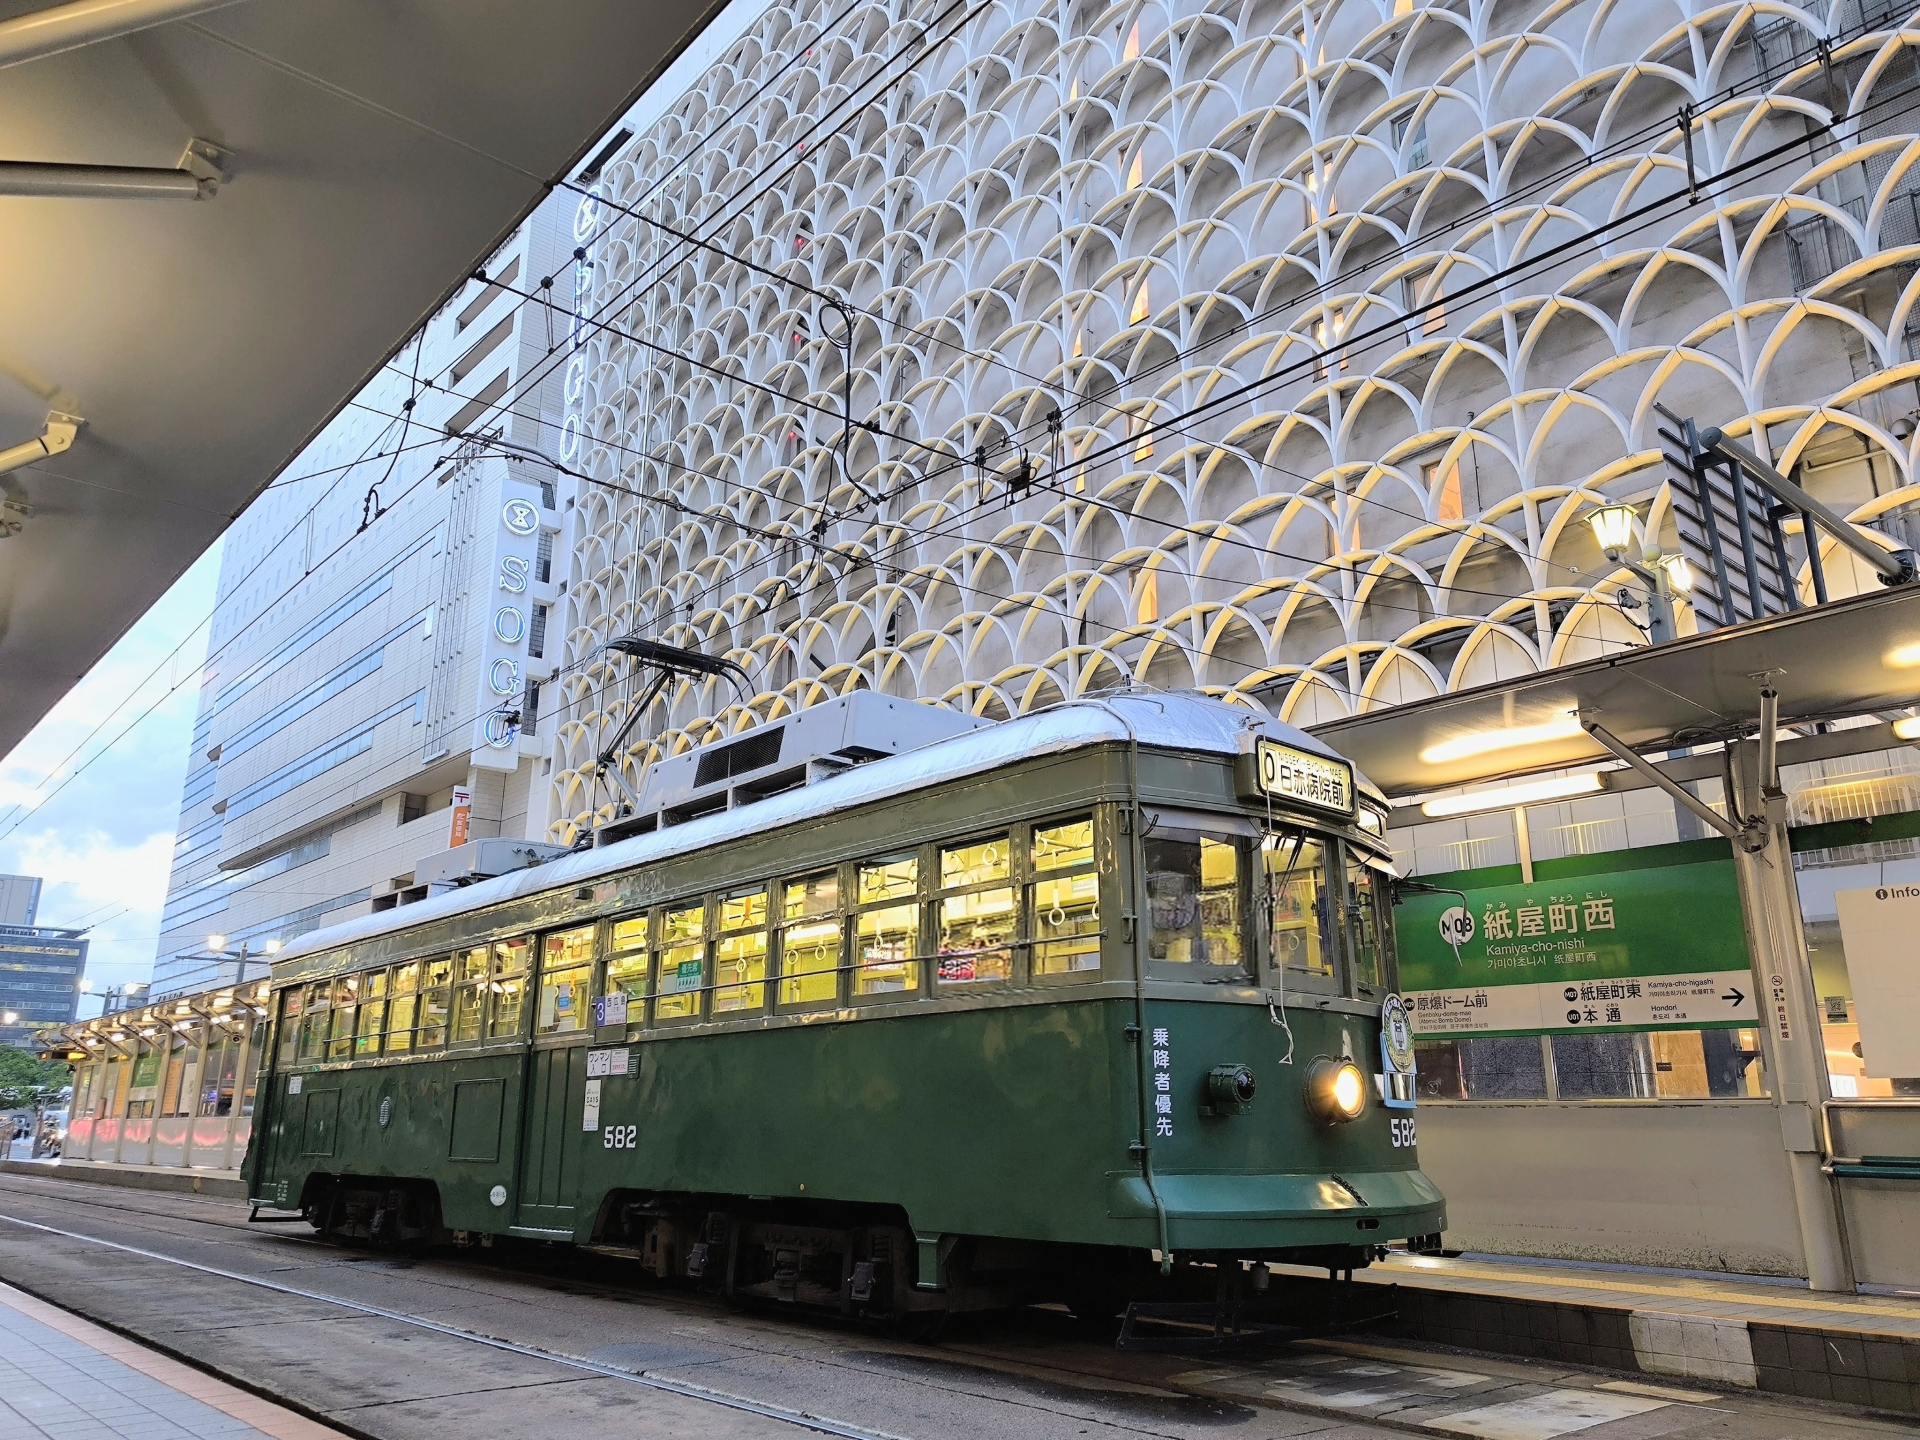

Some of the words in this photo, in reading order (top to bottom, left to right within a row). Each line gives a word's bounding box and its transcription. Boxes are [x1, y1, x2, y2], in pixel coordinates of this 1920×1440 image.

[484, 556, 529, 749] SOGO
[1281, 765, 1344, 807] 日赤病院前
[1485, 901, 1507, 911] かみ
[1526, 898, 1534, 906] や
[1550, 894, 1573, 904] ちょう
[1586, 891, 1608, 899] にし
[1891, 886, 1920, 899] Info
[1483, 898, 1616, 941] 紙屋町西
[1486, 937, 1585, 956] Kamiya-cho-nishi
[1487, 957, 1546, 969] 가미야초니시
[1580, 983, 1642, 1001] 紙屋町東
[1648, 978, 1714, 989] Kamiya-cho-higashi
[1417, 994, 1488, 1010] 原爆ドーム前
[1651, 1004, 1677, 1012] Hondori
[597, 1003, 605, 1021] 3
[589, 1052, 610, 1063] ワンマン
[590, 1063, 607, 1075] 入口
[1152, 1028, 1173, 1137] 乗降者優先
[604, 1125, 637, 1149] 582
[1390, 1118, 1417, 1148] 582
